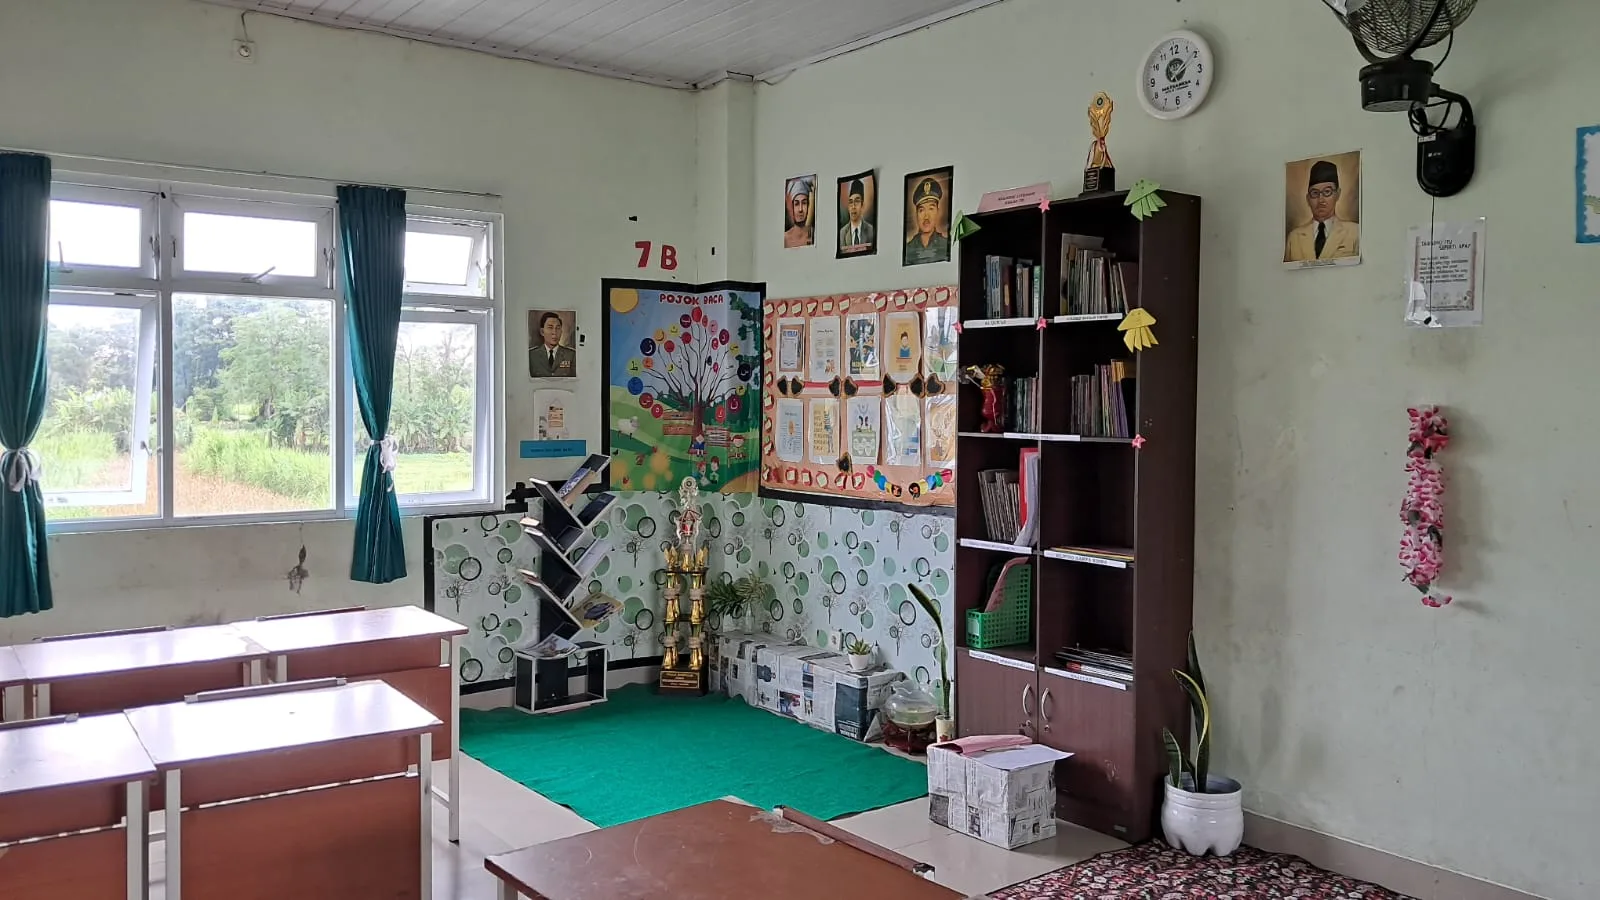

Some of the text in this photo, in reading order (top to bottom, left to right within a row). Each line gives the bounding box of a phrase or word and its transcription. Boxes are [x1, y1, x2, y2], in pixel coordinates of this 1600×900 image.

[1169, 44, 1179, 56] 12
[1193, 50, 1198, 59] 2
[1160, 53, 1167, 61] 11
[1152, 63, 1160, 71] 10
[1197, 63, 1203, 73] 3
[1150, 78, 1156, 88] 9
[1195, 79, 1200, 87] 4
[1154, 91, 1159, 99] 8
[1187, 90, 1192, 98] 5
[1163, 97, 1168, 106] 7
[1175, 96, 1181, 106] 6
[634, 240, 678, 271] 7 B
[659, 293, 700, 306] POJOK
